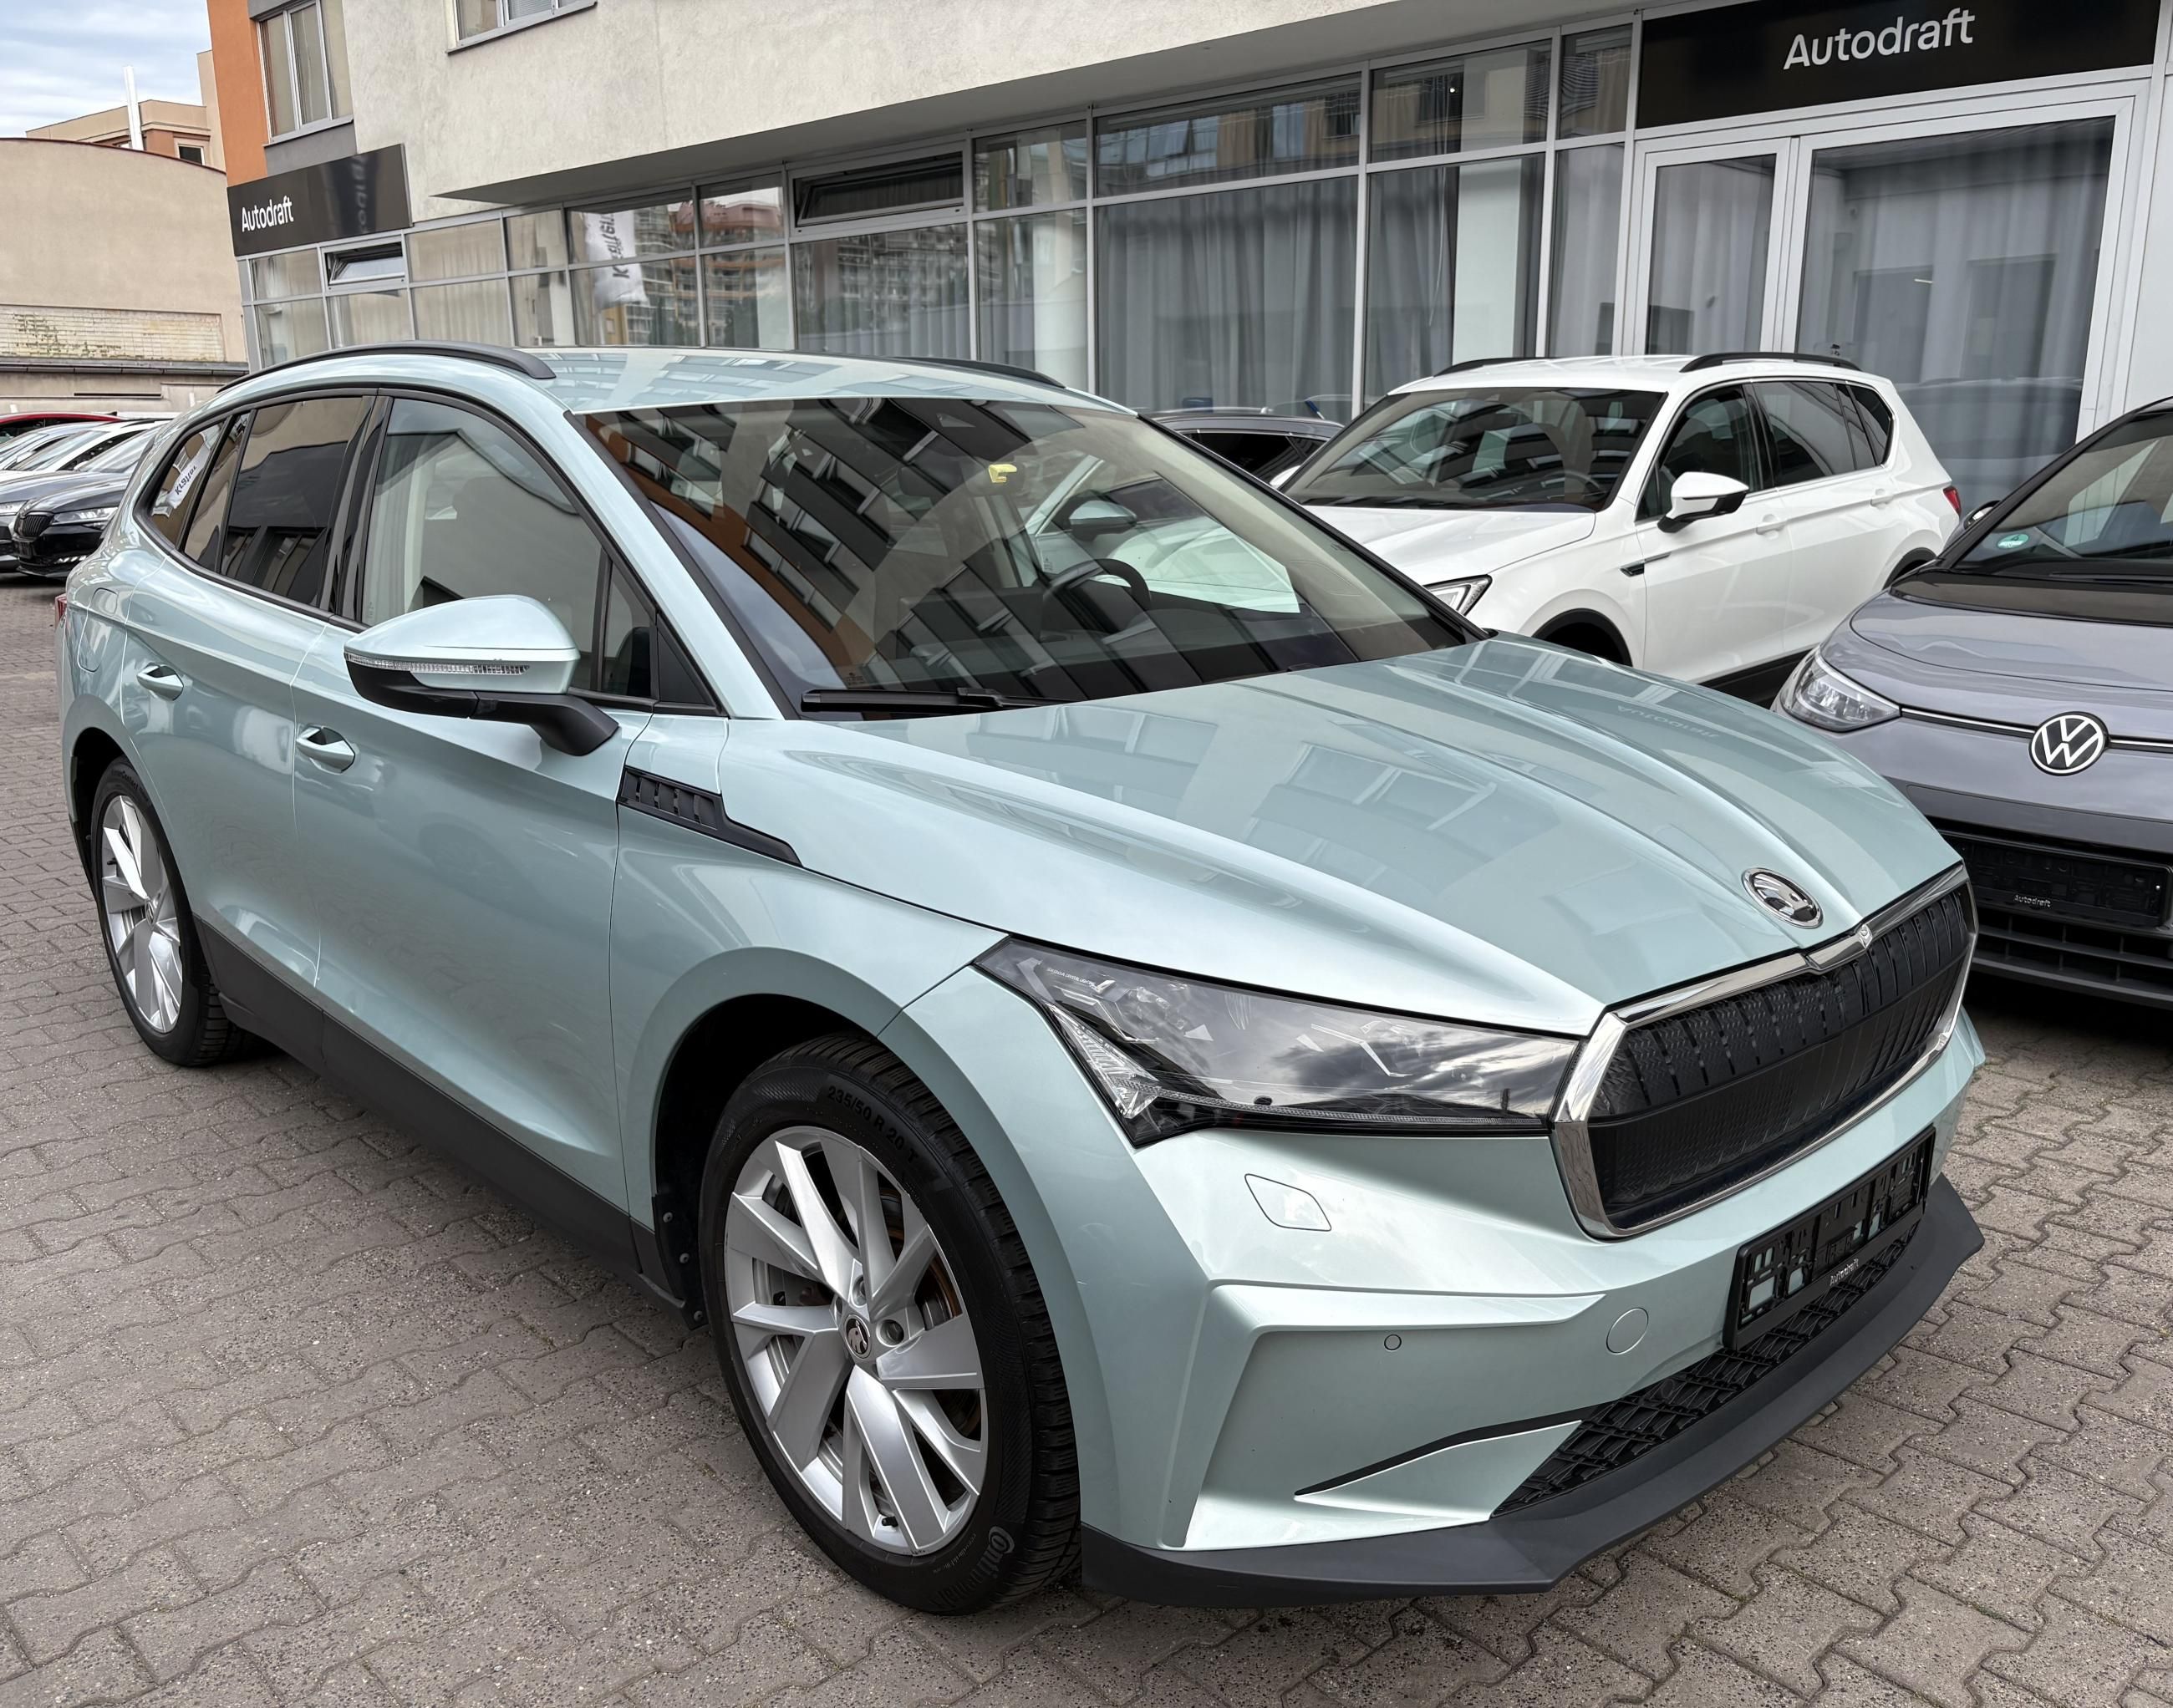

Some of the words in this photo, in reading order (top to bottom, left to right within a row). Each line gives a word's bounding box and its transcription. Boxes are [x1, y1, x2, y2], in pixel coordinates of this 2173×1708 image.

[1783, 7, 1976, 70] Autodraft
[241, 195, 294, 232] Autodraft
[2013, 894, 2051, 908] Autodraft
[827, 1085, 872, 1121] 235/50
[873, 1114, 886, 1131] R
[886, 1127, 905, 1151] 20
[1829, 1258, 1859, 1287] Autodraft
